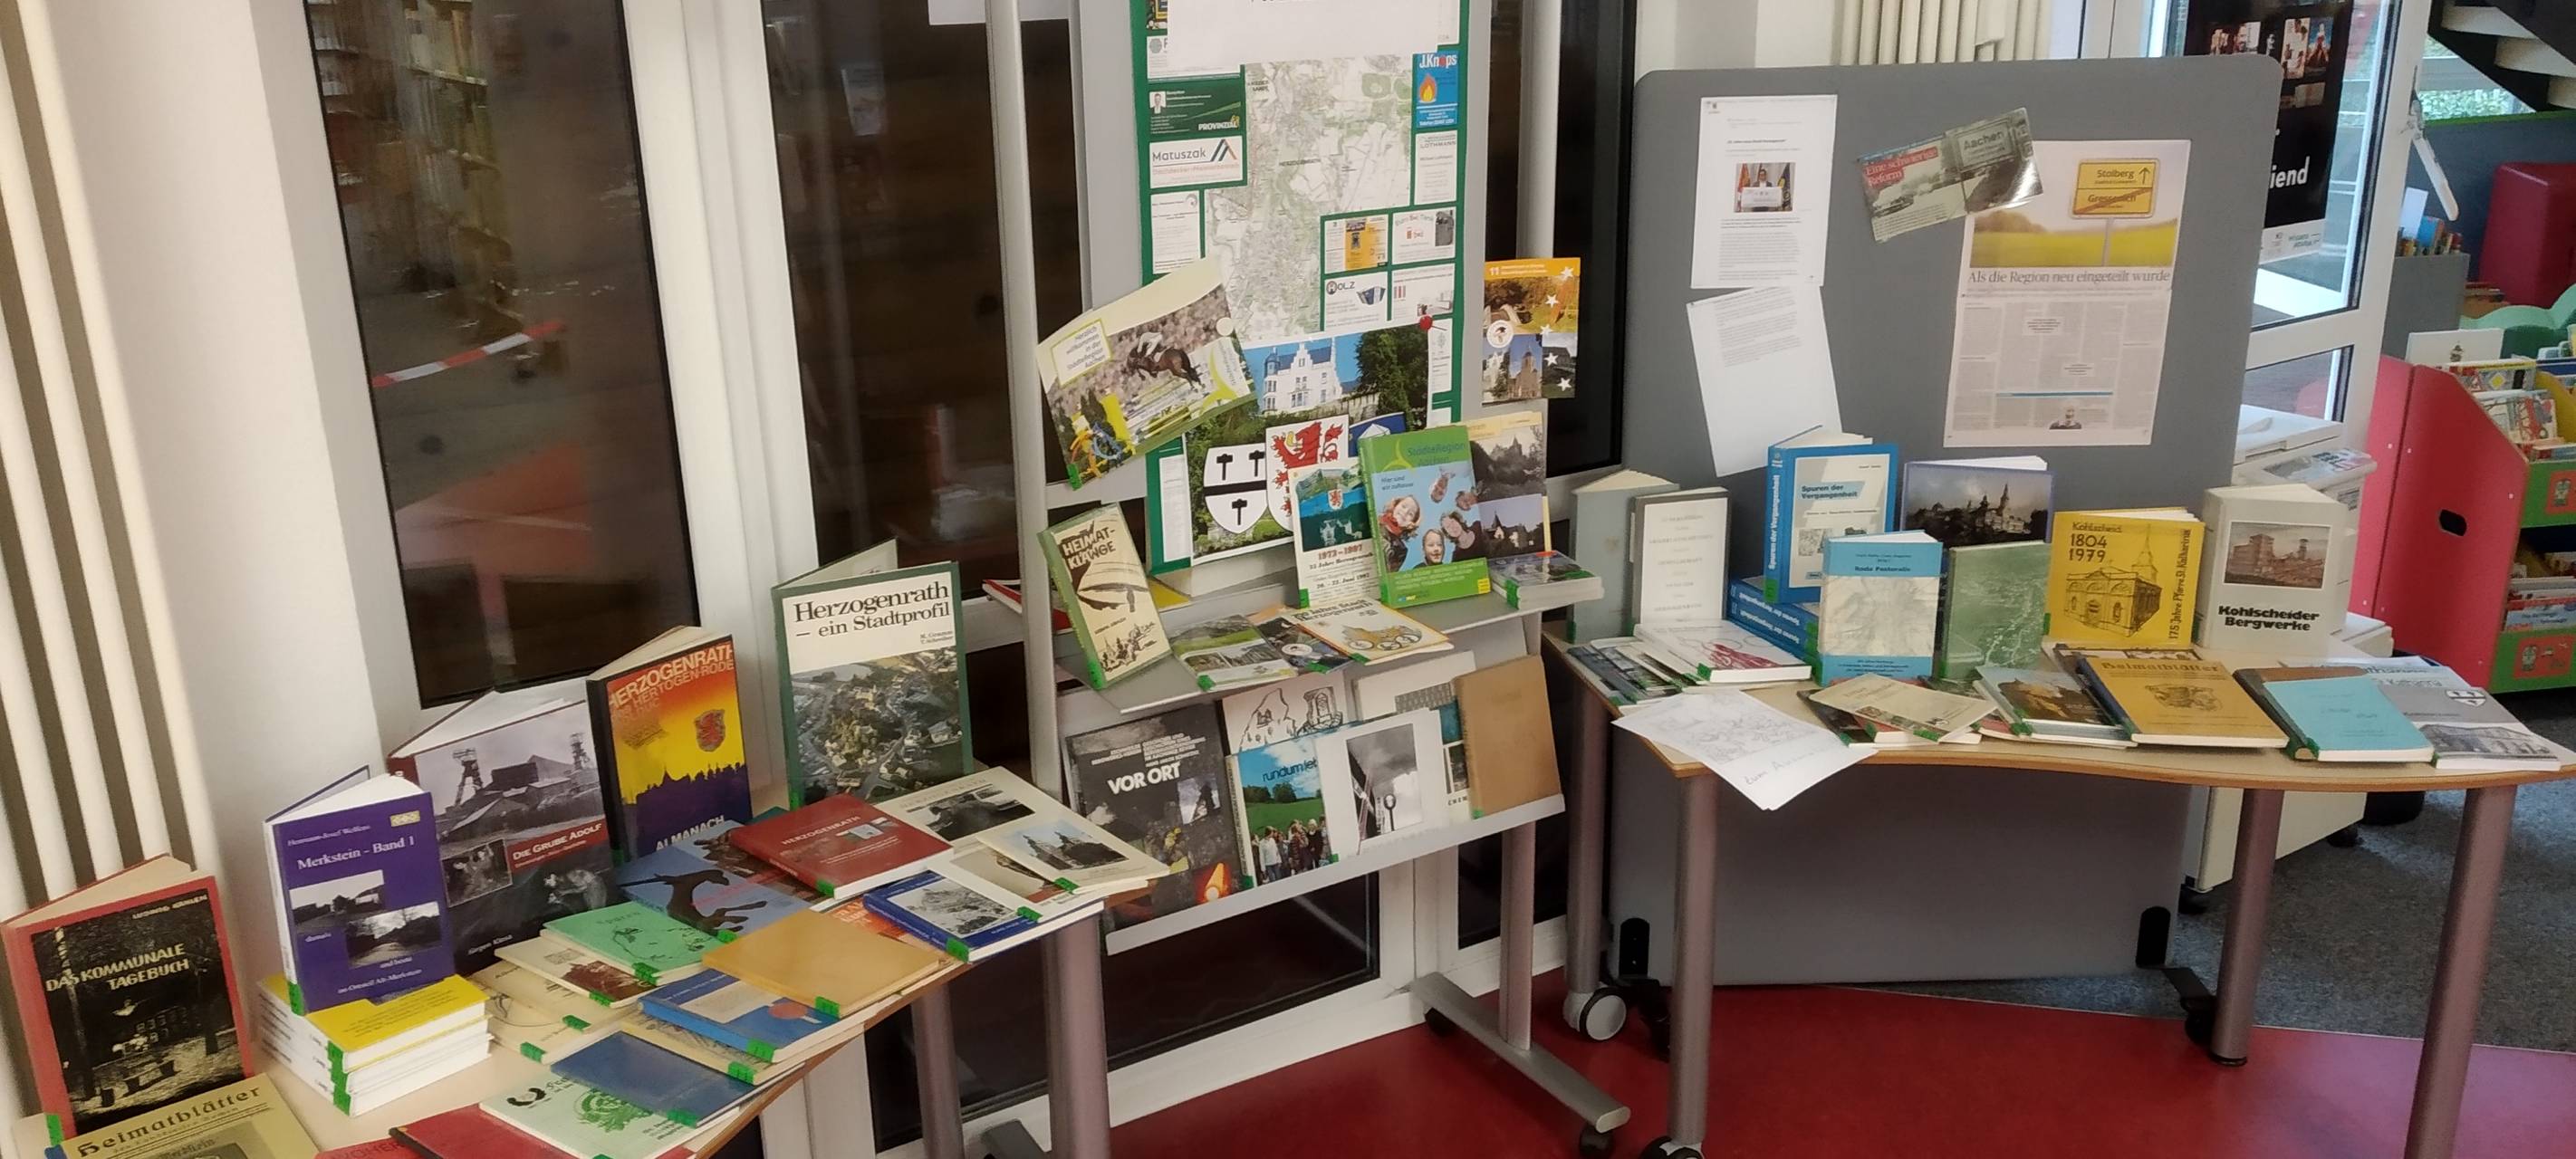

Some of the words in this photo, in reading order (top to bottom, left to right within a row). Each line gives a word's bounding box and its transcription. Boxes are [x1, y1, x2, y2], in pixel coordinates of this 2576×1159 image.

[1152, 148, 1206, 162] Matuszak
[2097, 169, 2135, 179] Stolberg
[1968, 272, 1987, 283] Als
[1988, 271, 2006, 283] die
[2010, 272, 2049, 286] Region
[2052, 273, 2074, 283] neu
[2077, 271, 2129, 284] eingeteilt
[2132, 270, 2170, 282] wurde
[1802, 485, 1829, 493] Spuren
[1802, 492, 1858, 500] Vergangenheit
[2071, 533, 2108, 549] 1804
[2069, 549, 2107, 562] 1979
[795, 580, 950, 623] Herzogenrath
[818, 620, 848, 637] ein
[853, 601, 950, 631] Stadtprofil
[2170, 602, 2182, 624] Jahre
[2218, 605, 2320, 621] Kohlscheider
[2225, 617, 2311, 631] Bergwerke
[2168, 624, 2179, 639] 175
[1107, 771, 1148, 795] VOR
[1147, 761, 1181, 784] ORT
[513, 848, 532, 861] DIE
[532, 834, 568, 855] GRUBE
[568, 823, 602, 841] ADOLF
[656, 815, 726, 852] ALMANACH
[782, 816, 861, 846] HERZOGENRATH
[297, 848, 361, 870] Merkstein
[372, 837, 406, 854] Band
[409, 836, 415, 847] 1
[46, 972, 80, 992] DAS
[81, 943, 186, 983] KOMMUNALE
[107, 959, 190, 991] TAGEBUCH
[77, 1087, 260, 1157] Heimatblätter
